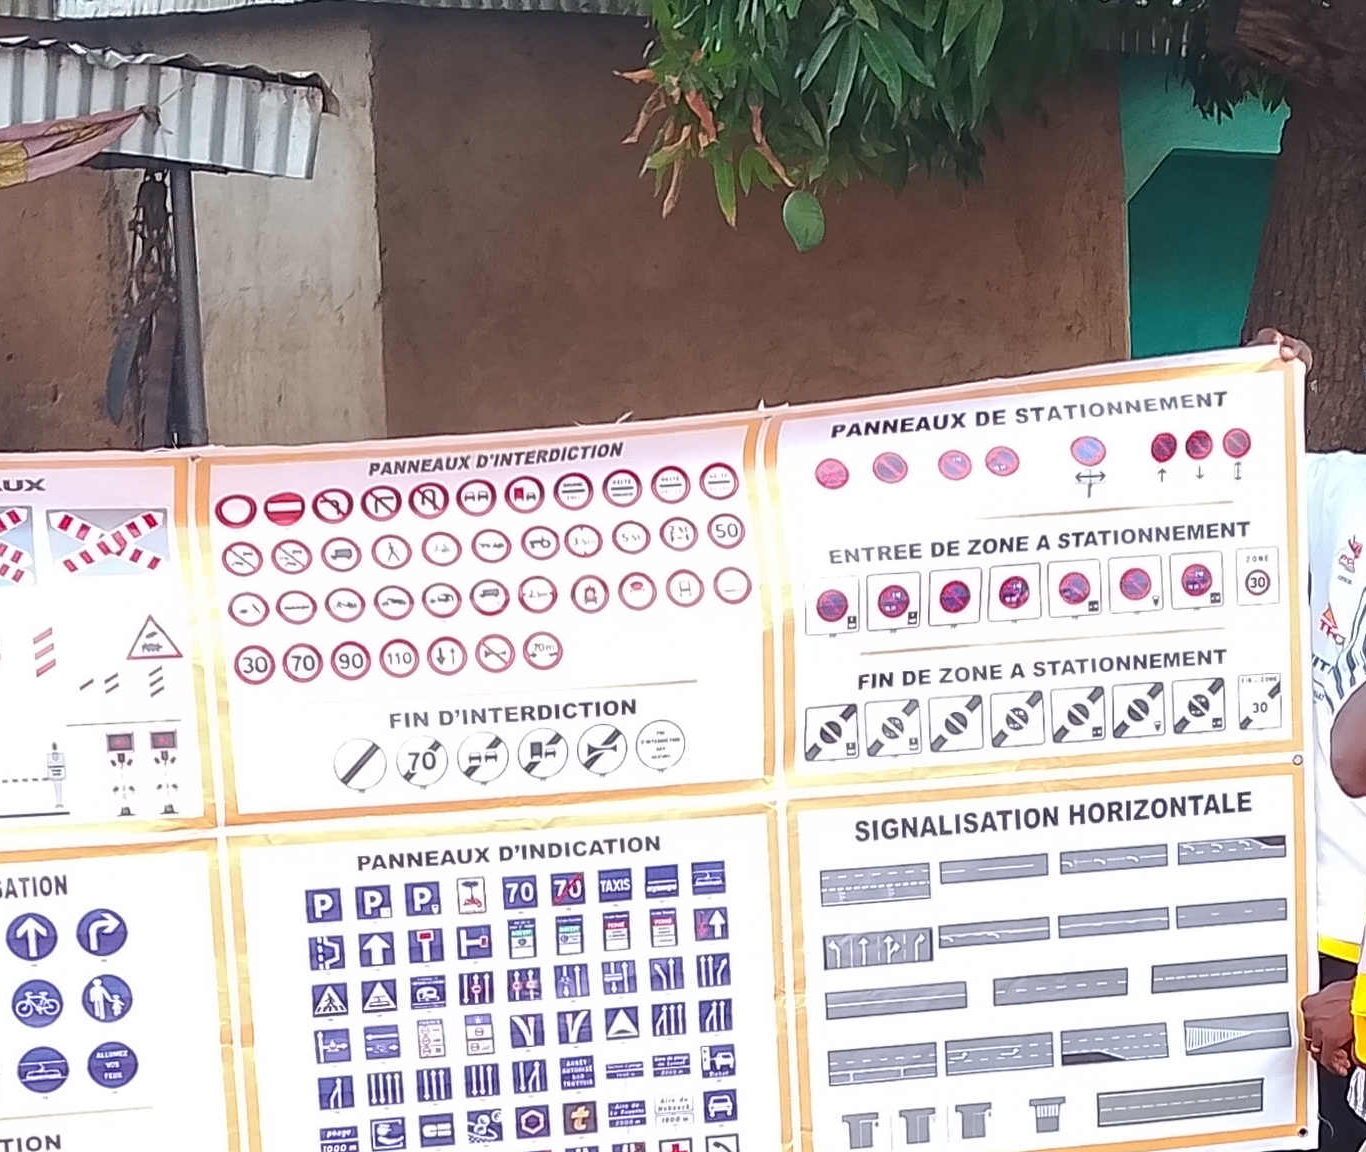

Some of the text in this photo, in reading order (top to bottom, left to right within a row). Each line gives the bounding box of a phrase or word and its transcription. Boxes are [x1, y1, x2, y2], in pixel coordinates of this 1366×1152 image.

[831, 391, 1228, 438] PANNEAUX DE STATIONNEMENT
[368, 442, 624, 477] PANNEAUX D'INTERDICTION
[715, 523, 738, 539] 50
[829, 521, 1251, 565] ENTREE DE ZONE A STATIONNEMENT
[1250, 577, 1266, 588] 30
[242, 656, 268, 674] 30
[291, 654, 316, 672] 70
[338, 653, 364, 669] 90
[387, 652, 412, 665] 110
[858, 649, 1228, 690] FIN DE ZONE A STATIONNEMENT
[389, 699, 637, 729] FIN D'INTERDICTION
[1253, 702, 1268, 713] 30
[407, 751, 436, 771] 70
[854, 791, 1253, 843] SIGNALISATION HORIZONTALE
[357, 835, 661, 871] PANNEAUX D'INDICATION
[505, 882, 534, 903] 70
[599, 878, 631, 893] TAXIS
[314, 893, 333, 919] P
[363, 890, 383, 916] P
[413, 887, 432, 912] P
